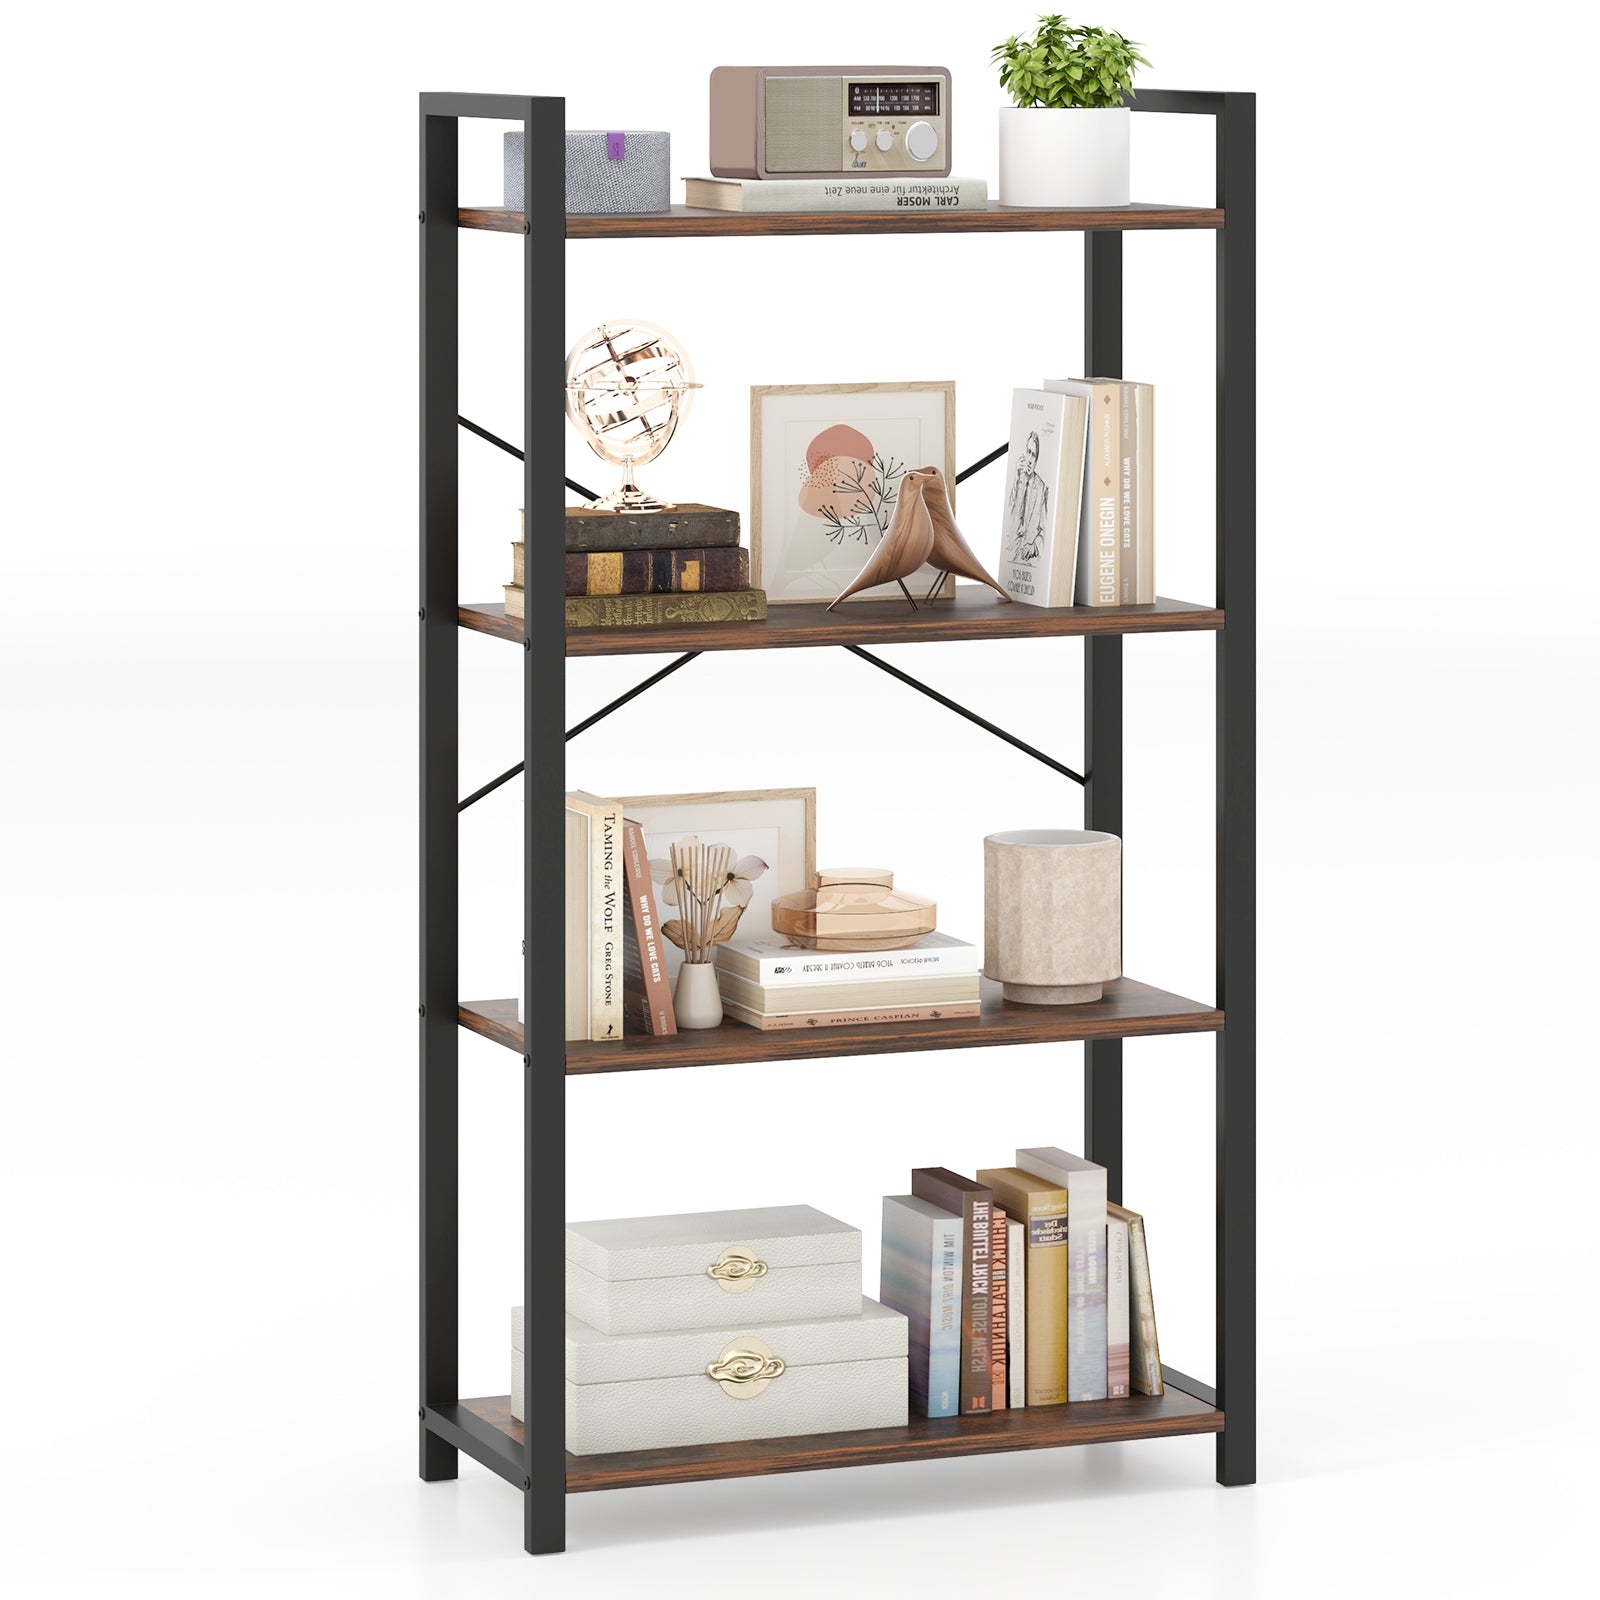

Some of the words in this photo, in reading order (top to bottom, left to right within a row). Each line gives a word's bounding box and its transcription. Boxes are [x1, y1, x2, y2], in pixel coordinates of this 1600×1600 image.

[824, 186, 842, 196] Zeit
[846, 186, 867, 194] neue
[870, 186, 890, 196] eine
[892, 185, 906, 196] für
[908, 185, 960, 196] Architektur
[896, 196, 931, 206] MOSER
[935, 196, 960, 206] CARL
[1124, 478, 1130, 489] DO
[1124, 491, 1130, 504] WE
[1100, 498, 1115, 547] ONEGIN
[1100, 550, 1115, 602] EUGENE
[604, 813, 616, 870] TAMING
[604, 874, 613, 890] the
[640, 894, 650, 913] WHY
[604, 892, 616, 933] WOLF
[643, 914, 652, 926] DO
[645, 927, 654, 942] WE
[605, 942, 614, 971] GREG
[648, 942, 658, 960] LOVE
[651, 961, 661, 983] CATS
[605, 973, 613, 1006] STONE
[830, 1016, 869, 1024] PRINCE
[873, 1013, 920, 1021] CASPIAN
